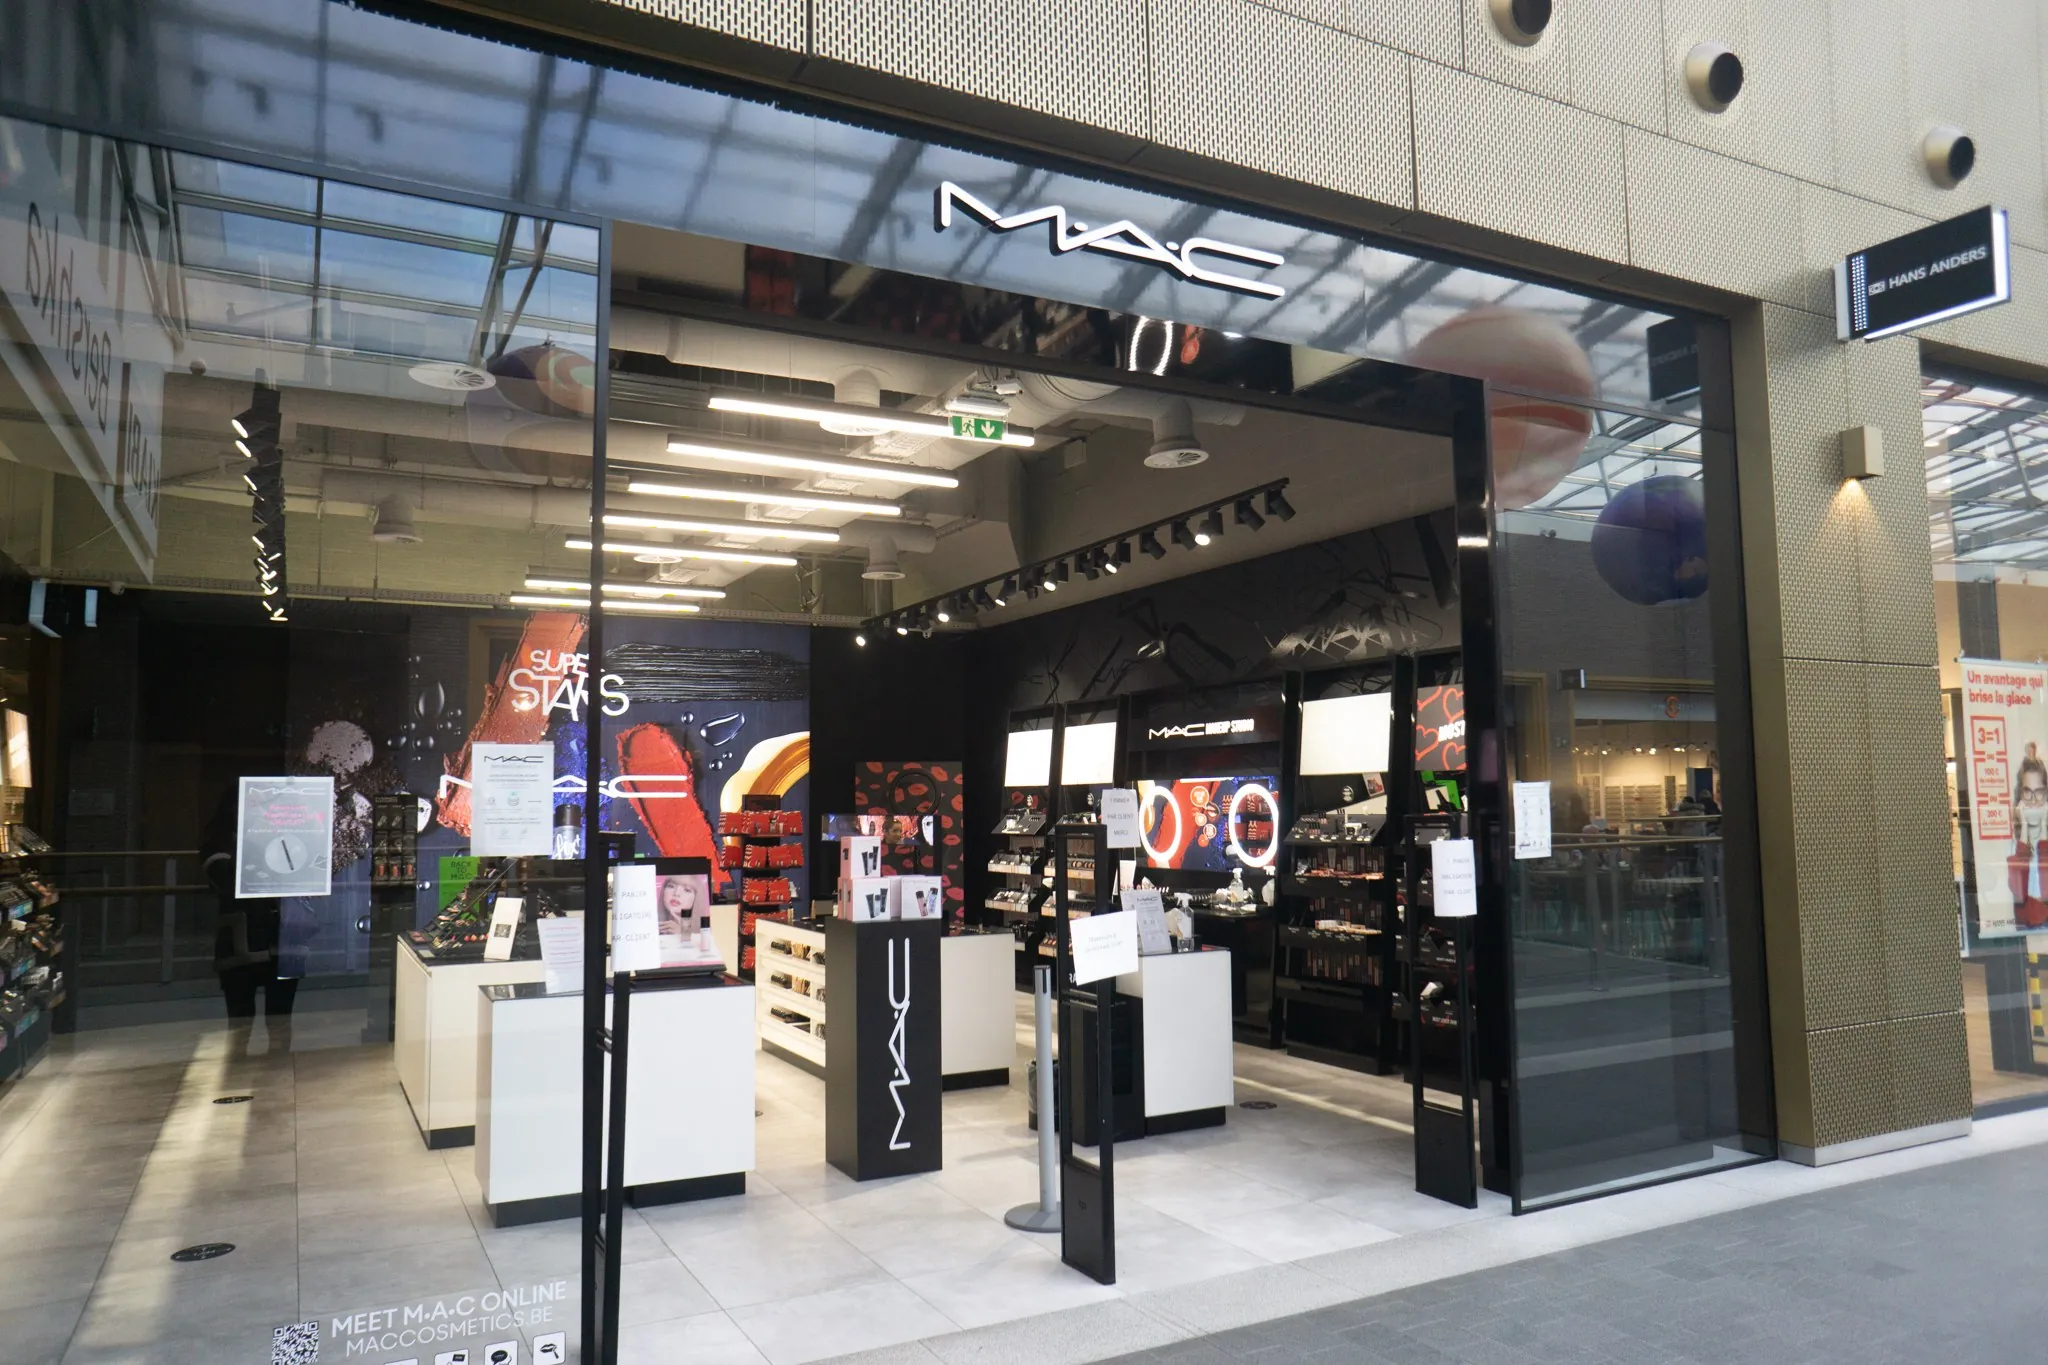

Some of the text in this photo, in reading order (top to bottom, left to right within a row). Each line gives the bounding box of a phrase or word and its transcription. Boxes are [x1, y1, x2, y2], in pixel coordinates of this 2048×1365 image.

[1889, 246, 1987, 289] HANS ANDERS
[530, 649, 589, 675] SUPE
[1967, 670, 2044, 690] Un avantage qui
[1968, 688, 2032, 708] brise la glace
[1977, 726, 2000, 745] 3=1
[331, 1307, 399, 1338] MEET
[480, 1280, 567, 1312] ONLINE
[345, 1305, 553, 1358] MACCOSMETICS.BE
